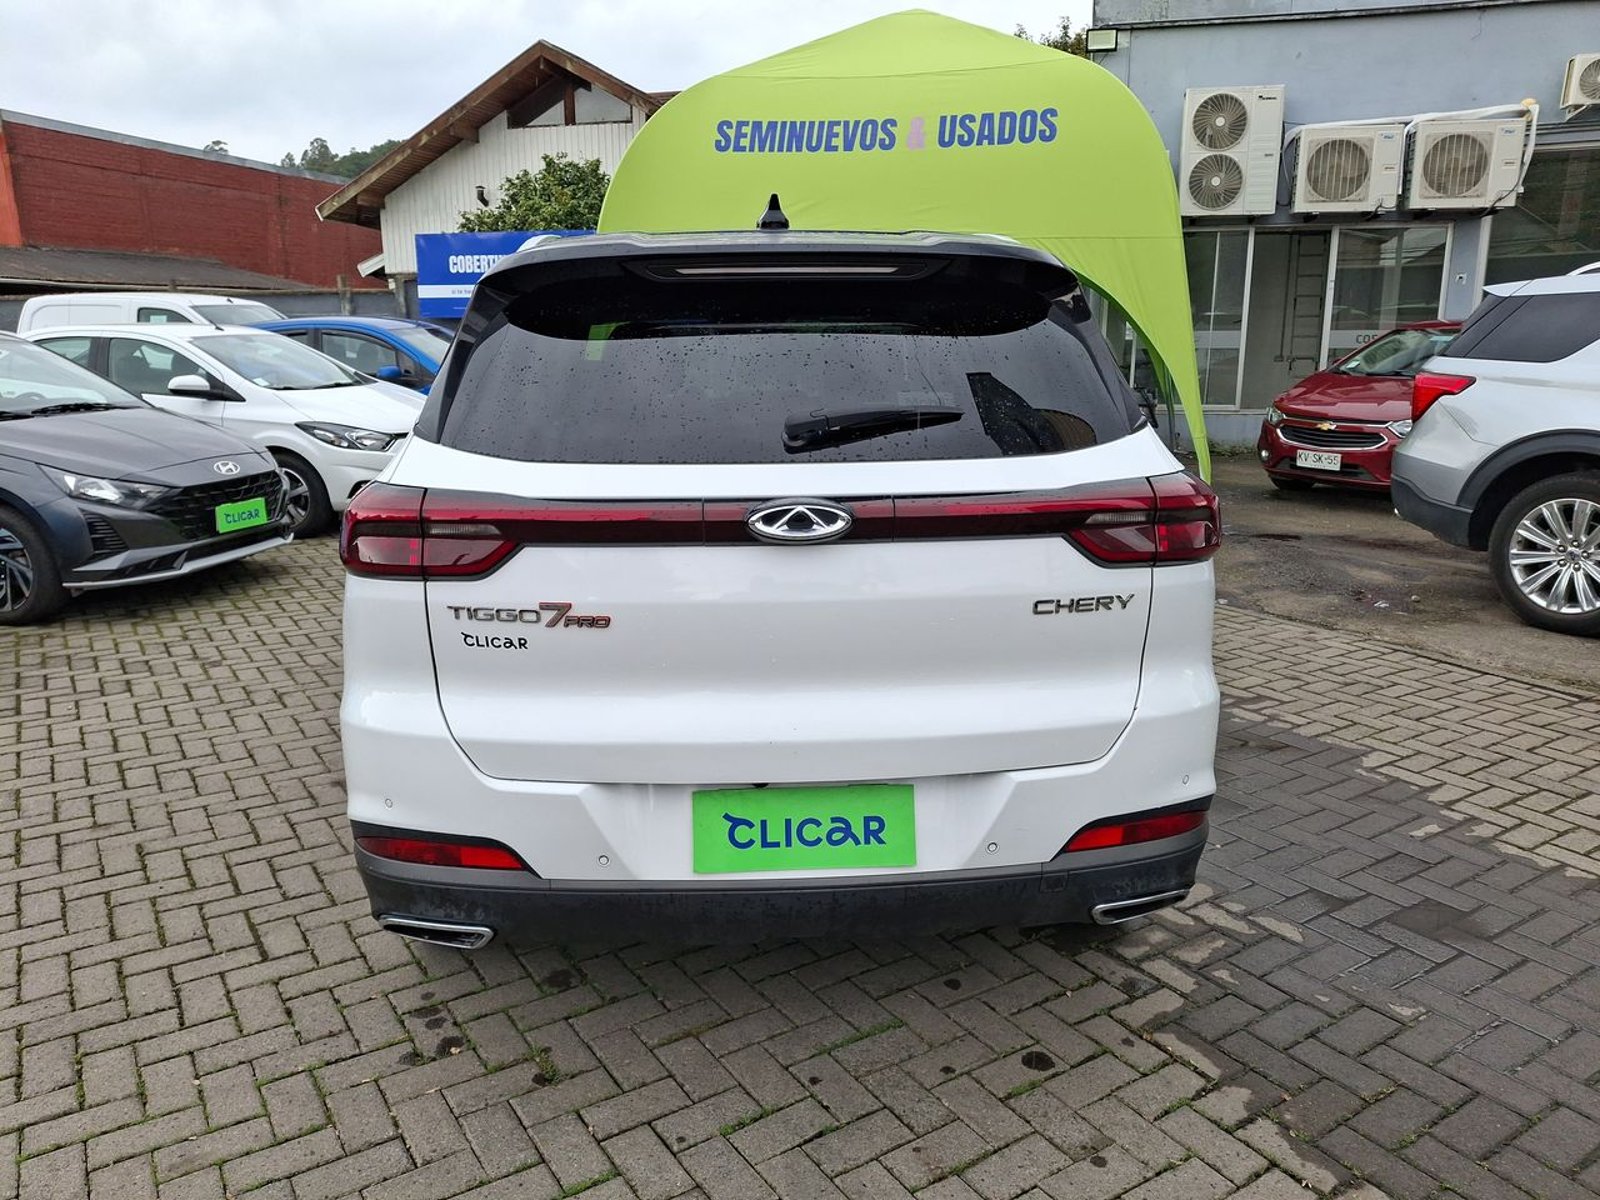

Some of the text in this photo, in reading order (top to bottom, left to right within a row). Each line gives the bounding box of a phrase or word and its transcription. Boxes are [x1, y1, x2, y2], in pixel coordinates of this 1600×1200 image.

[714, 107, 1059, 153] SEMINUEVOS & USADOS
[1032, 593, 1135, 615] CHERY
